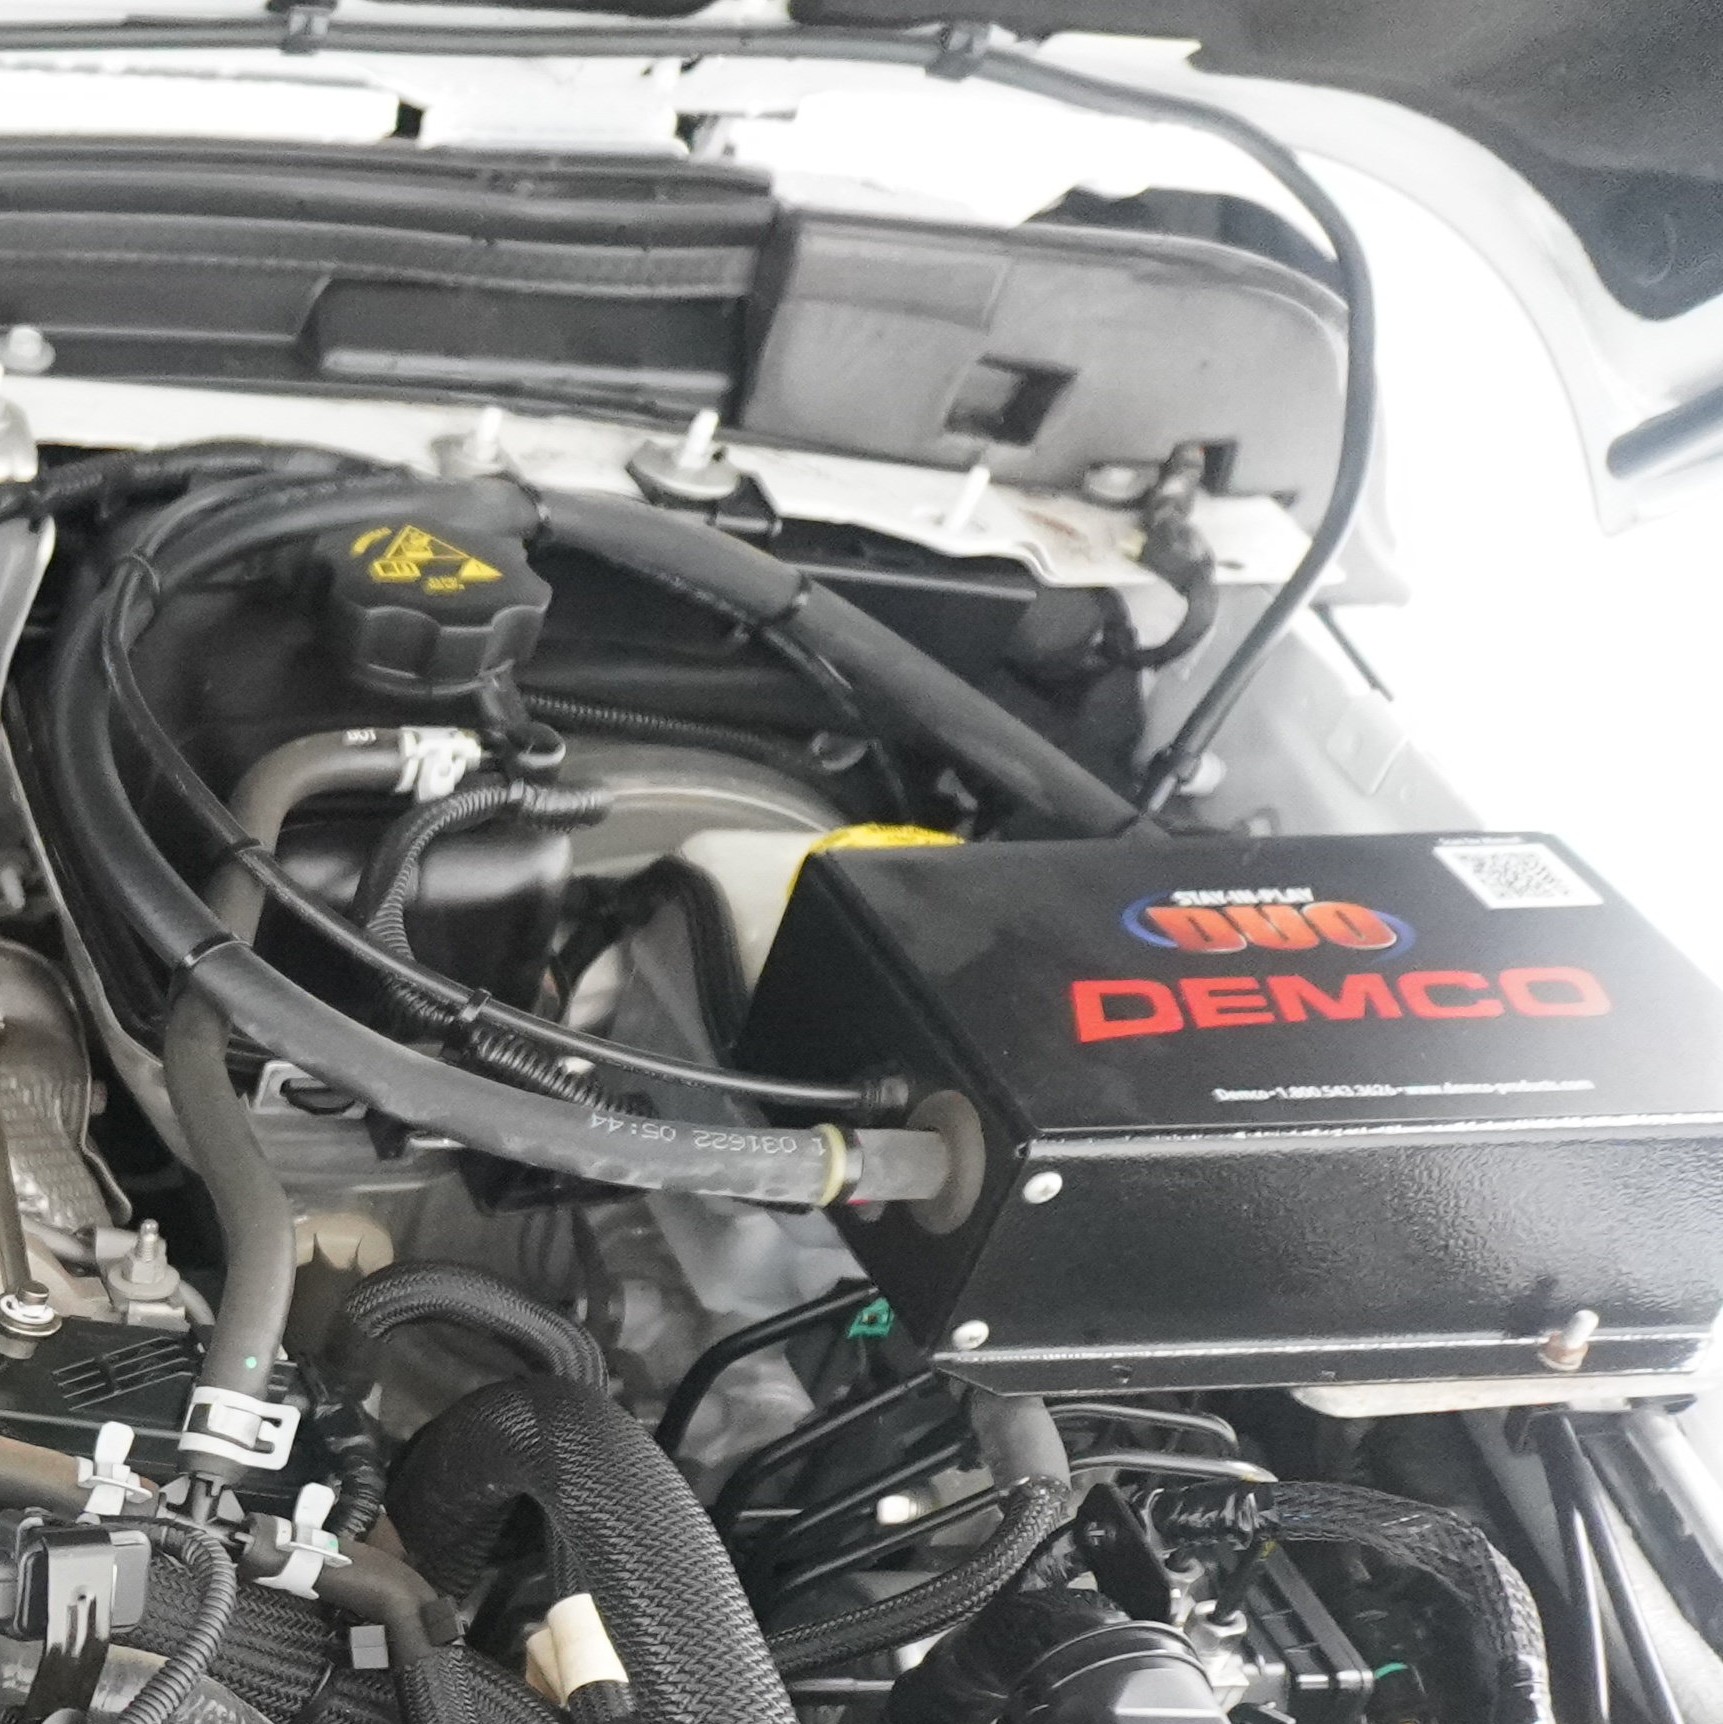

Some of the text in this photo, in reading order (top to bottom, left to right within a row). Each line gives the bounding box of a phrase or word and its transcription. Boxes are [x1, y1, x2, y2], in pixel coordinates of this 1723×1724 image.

[1146, 902, 1397, 954] DUO
[1069, 968, 1611, 1043] DEMCO
[589, 1111, 677, 1143] 05:44
[692, 1129, 798, 1155] 031622
